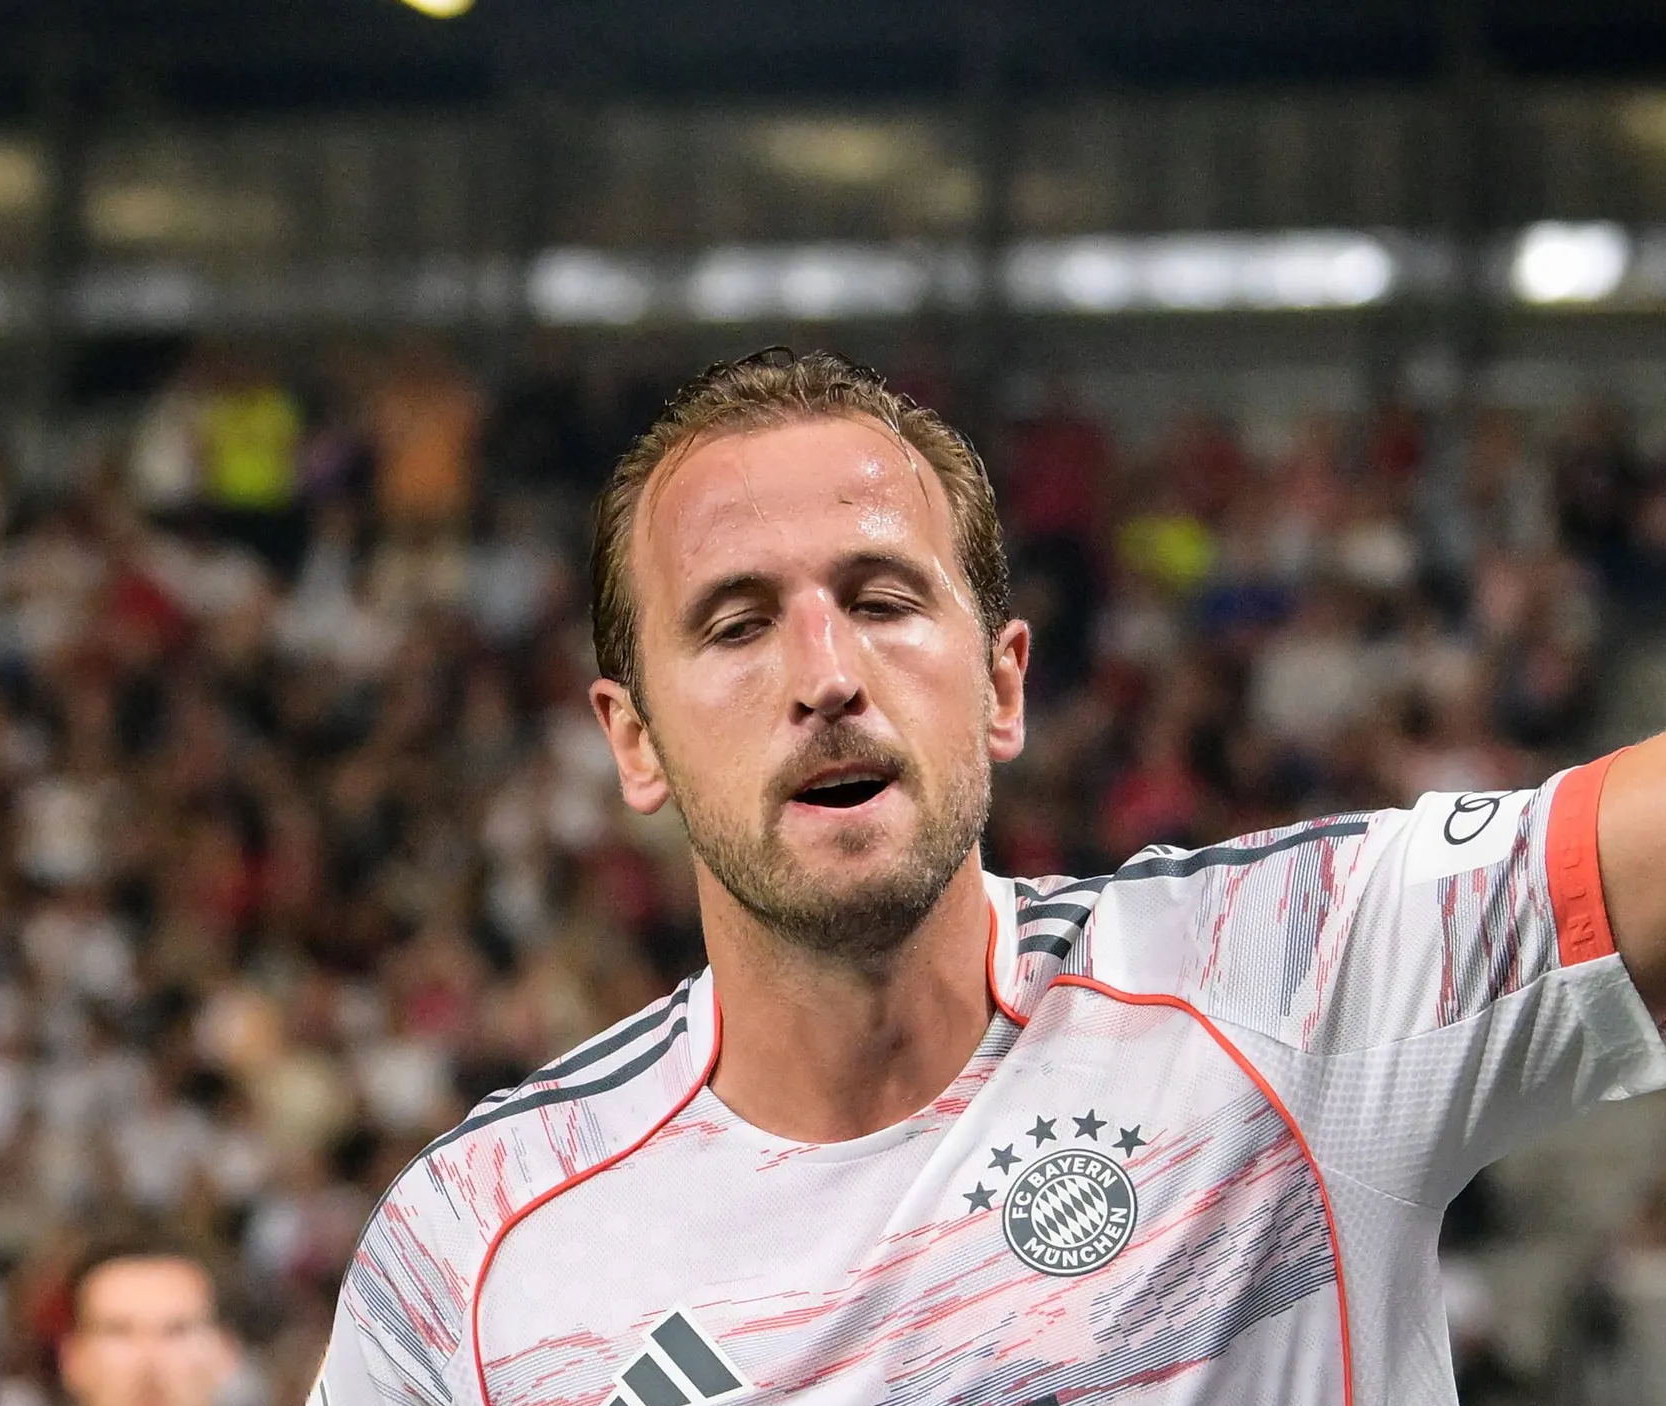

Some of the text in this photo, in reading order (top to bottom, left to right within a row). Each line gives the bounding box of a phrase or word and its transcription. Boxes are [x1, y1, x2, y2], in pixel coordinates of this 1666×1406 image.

[1012, 1156, 1118, 1219] FC BAYERN
[1023, 1207, 1128, 1267] MÜNCHEN
